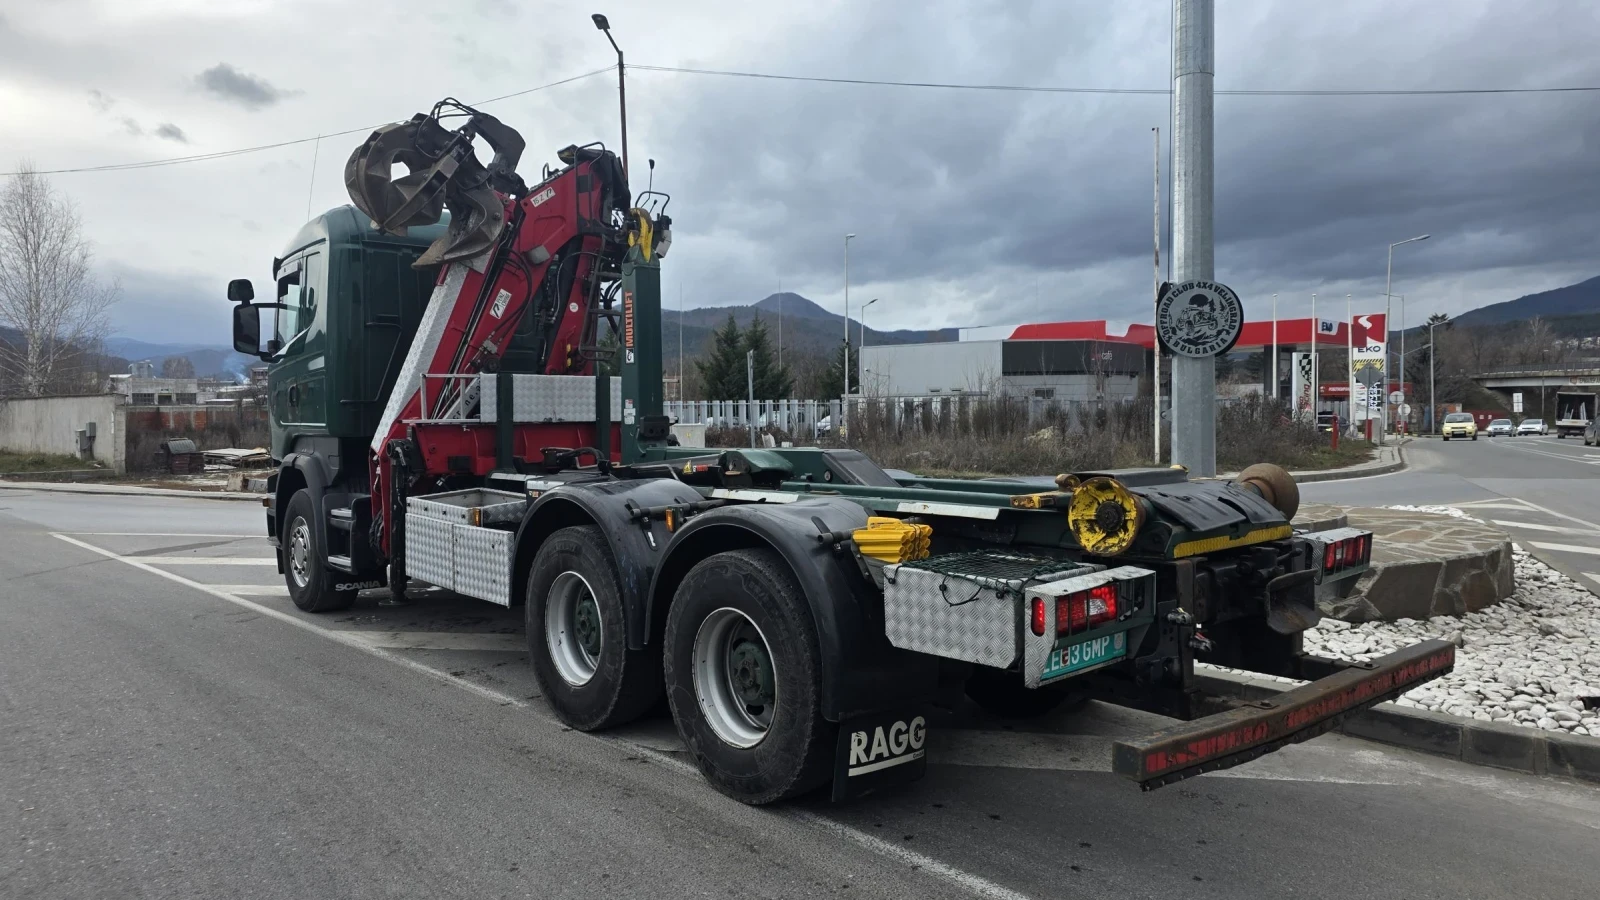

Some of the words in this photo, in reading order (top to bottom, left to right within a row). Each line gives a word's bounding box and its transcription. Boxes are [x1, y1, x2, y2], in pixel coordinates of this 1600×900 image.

[625, 291, 634, 348] MULTILIFT
[1160, 296, 1174, 336] OFFROAD
[1171, 282, 1195, 298] CLUB
[1195, 281, 1214, 291] 4X4
[1213, 284, 1238, 331] VELINGRAD
[1172, 337, 1228, 355] BULGARIA
[1357, 345, 1381, 353] EKO
[335, 580, 381, 592] SCANIA
[1082, 635, 1110, 662] GMP
[849, 715, 926, 766] RAGG
